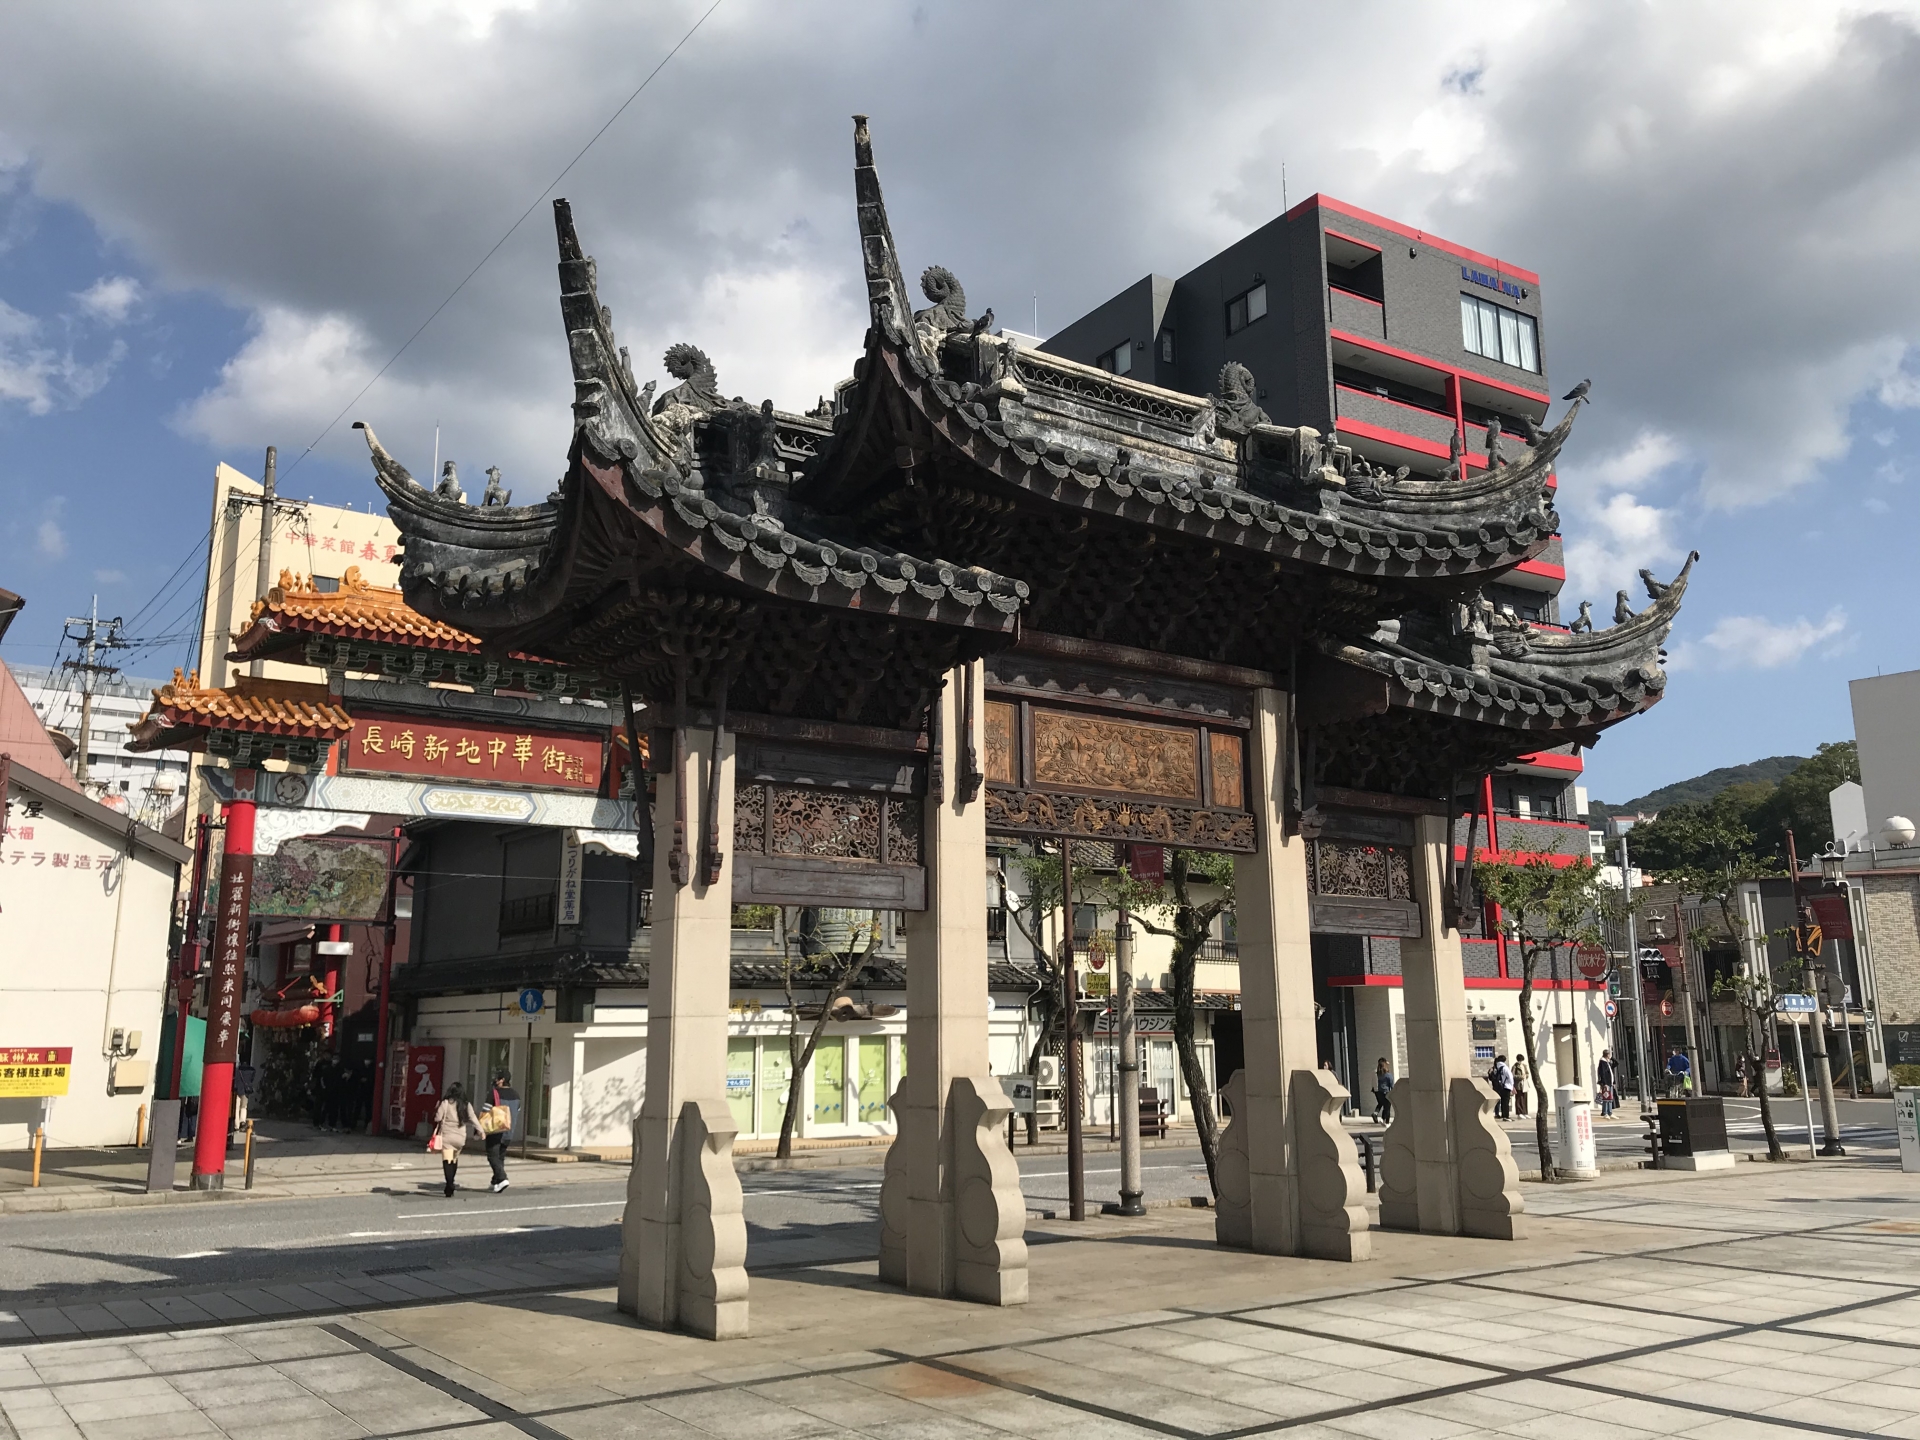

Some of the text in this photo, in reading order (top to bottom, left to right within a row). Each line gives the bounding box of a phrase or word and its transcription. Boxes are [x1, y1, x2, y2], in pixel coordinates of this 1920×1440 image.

[1461, 265, 1521, 299] LAHAINA
[361, 725, 566, 775] 長崎新地中華街
[563, 850, 578, 921] つりがね堂薬局
[0, 1067, 66, 1078] 客様駐車場
